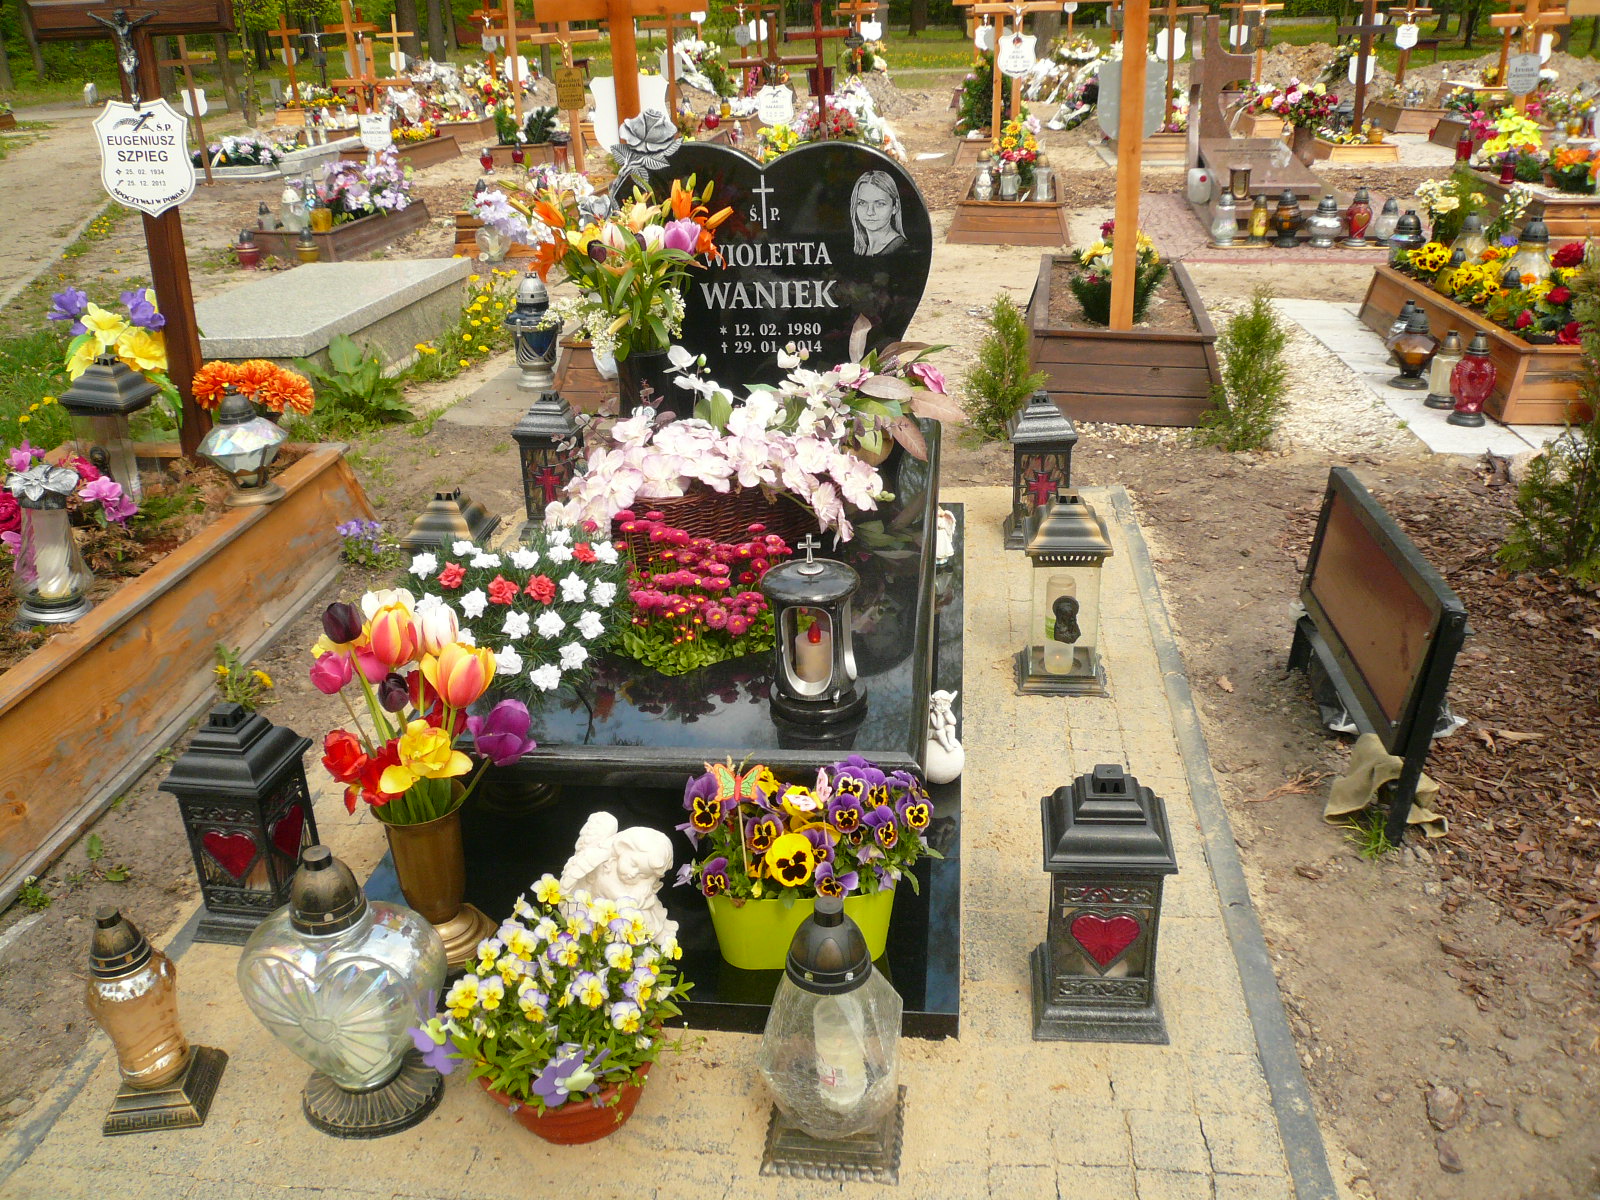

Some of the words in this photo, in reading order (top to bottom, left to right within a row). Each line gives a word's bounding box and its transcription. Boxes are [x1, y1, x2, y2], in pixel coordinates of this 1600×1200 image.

[106, 135, 176, 146] EUGENIUSZ
[117, 150, 169, 162] SZPIEG
[769, 207, 781, 221] P.
[704, 242, 833, 267] WIOLETTA
[699, 280, 839, 310] WANIEK
[734, 323, 755, 336] 12.
[759, 323, 782, 336] 02.
[787, 322, 822, 336] 1980
[734, 341, 757, 354] 29.
